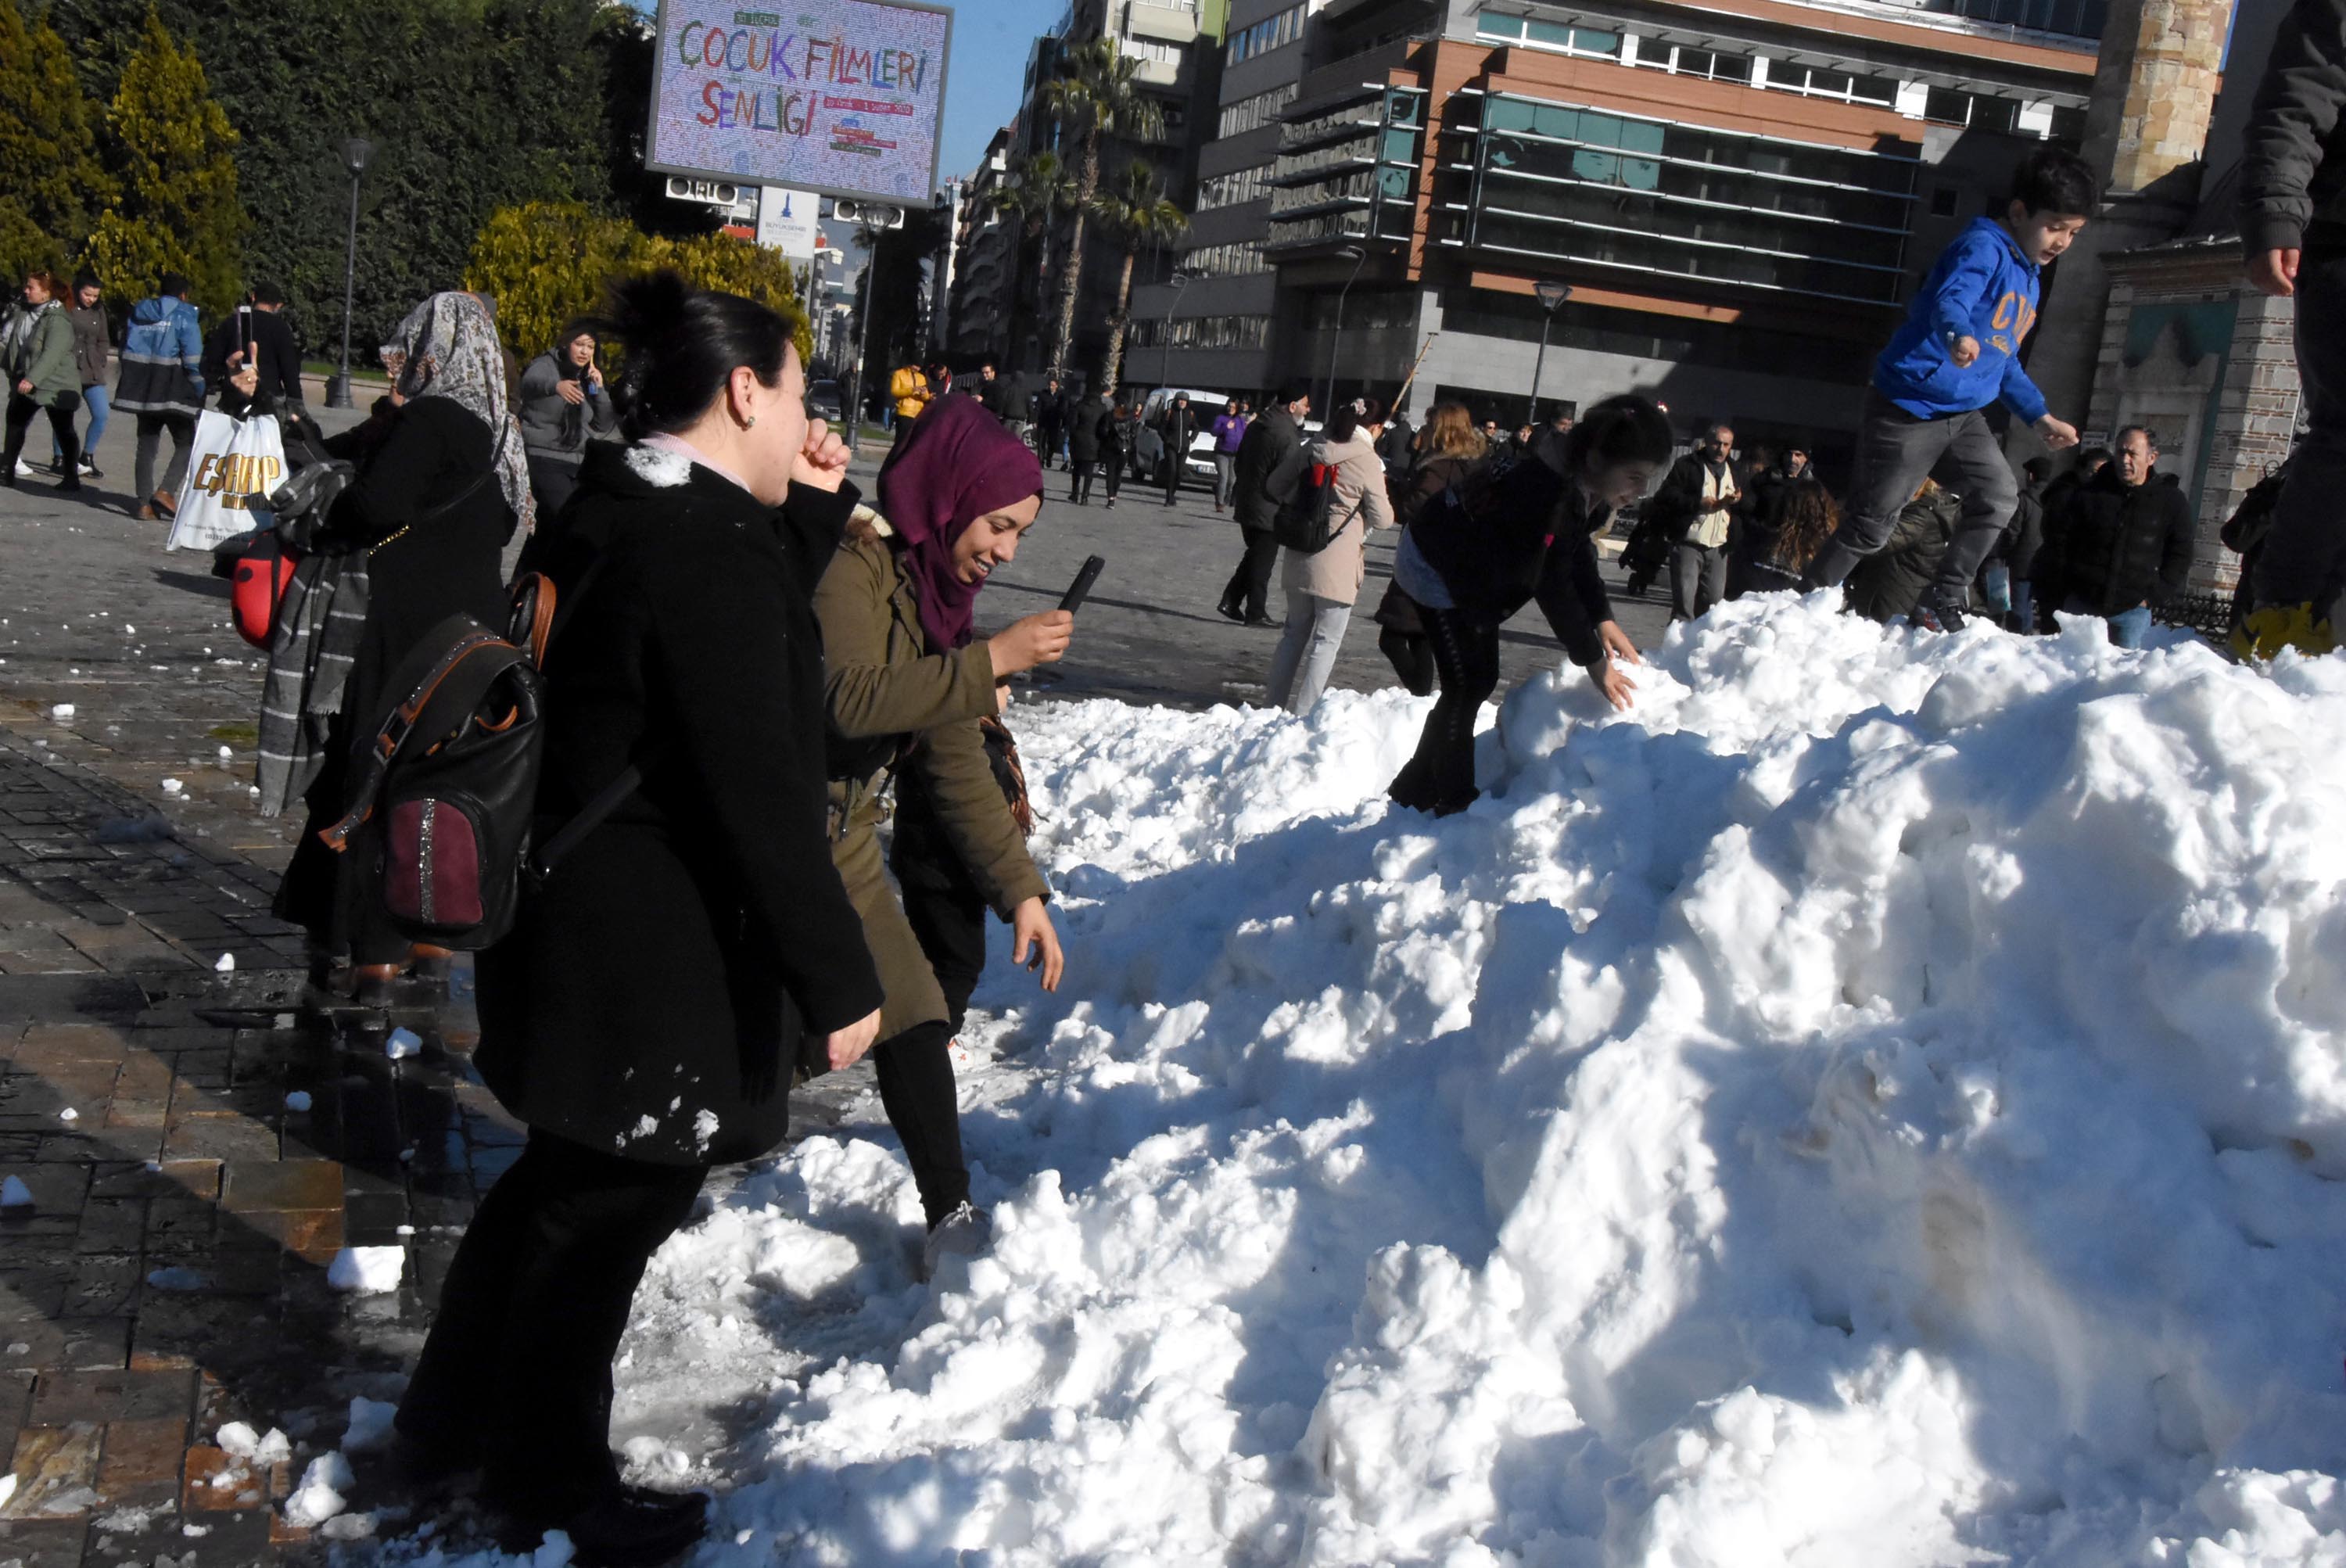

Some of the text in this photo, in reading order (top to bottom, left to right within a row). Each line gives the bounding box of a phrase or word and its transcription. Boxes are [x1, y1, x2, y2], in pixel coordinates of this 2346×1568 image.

[679, 20, 927, 95] ÇOCUK FİLMLERİ
[193, 453, 281, 501] EŞARP
